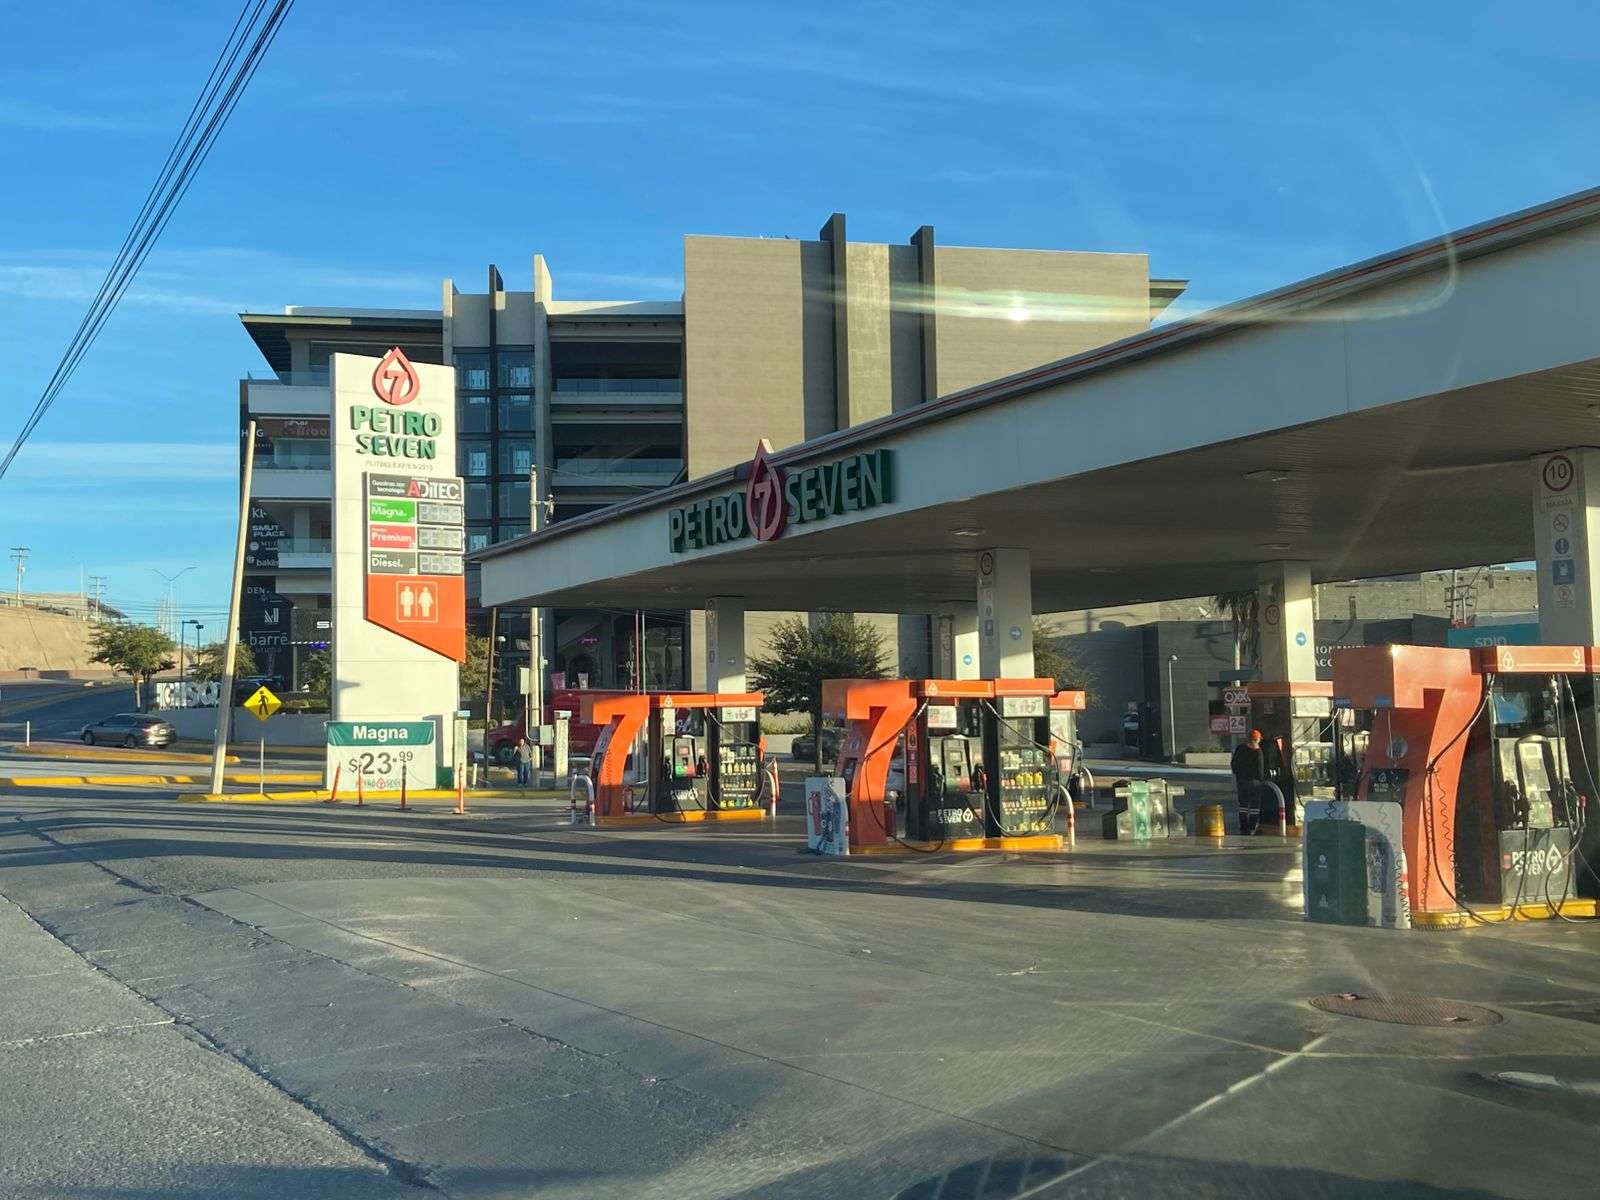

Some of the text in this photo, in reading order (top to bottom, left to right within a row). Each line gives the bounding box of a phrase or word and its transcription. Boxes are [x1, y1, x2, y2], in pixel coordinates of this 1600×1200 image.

[350, 405, 442, 437] PETRO
[355, 433, 436, 460] SEVEN
[1549, 463, 1568, 479] 10
[669, 492, 747, 553] PETRO
[784, 449, 891, 525] SEVEN
[371, 557, 402, 568] Diesel
[1224, 691, 1251, 703] OXX
[1231, 718, 1245, 728] 24
[352, 726, 409, 742] Magna
